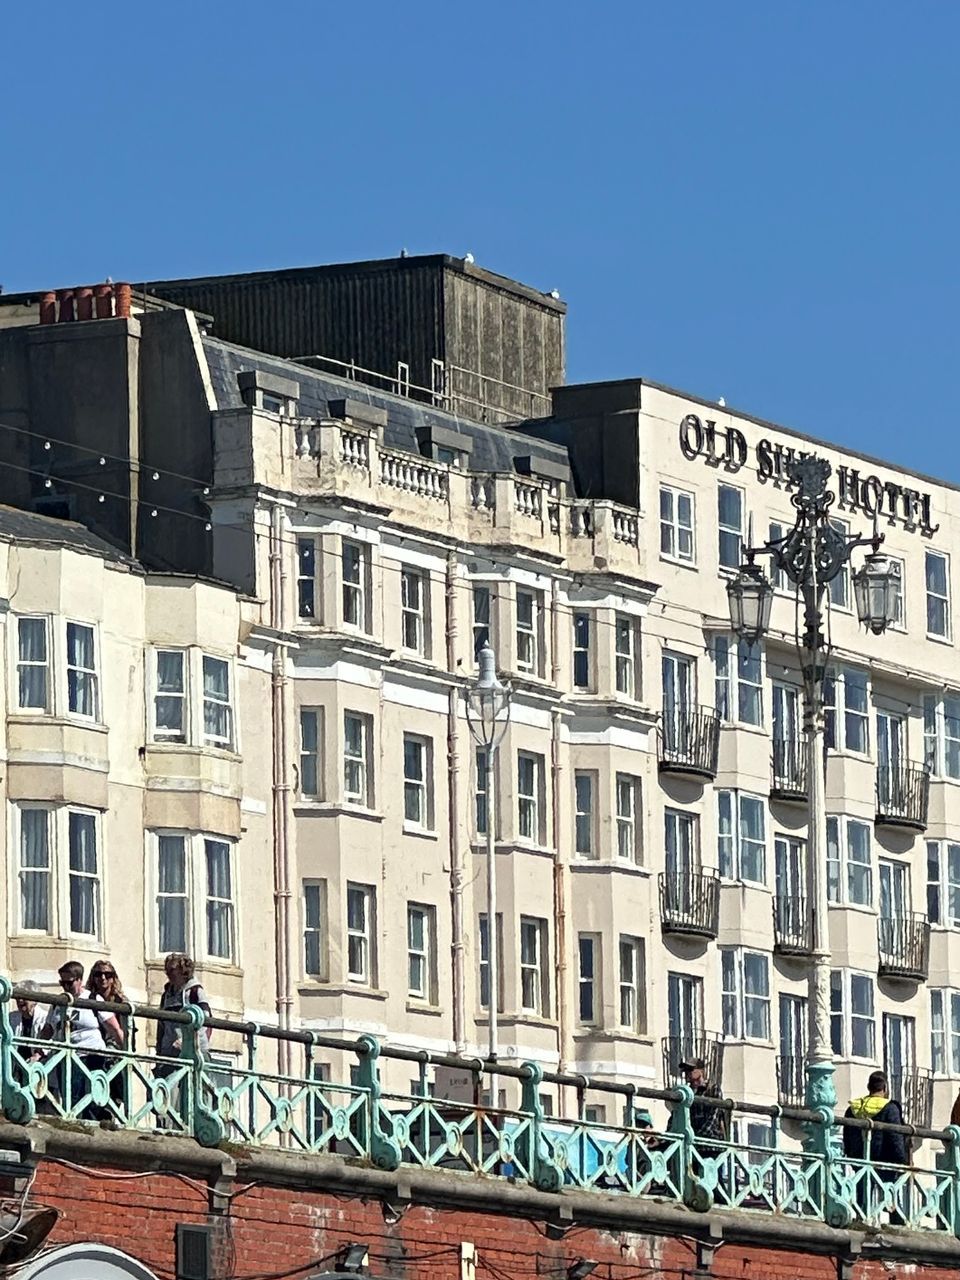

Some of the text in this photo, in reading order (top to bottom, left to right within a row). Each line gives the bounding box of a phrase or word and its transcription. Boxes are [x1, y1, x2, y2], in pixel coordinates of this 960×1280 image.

[679, 414, 940, 539] OLD SH HOTEL
